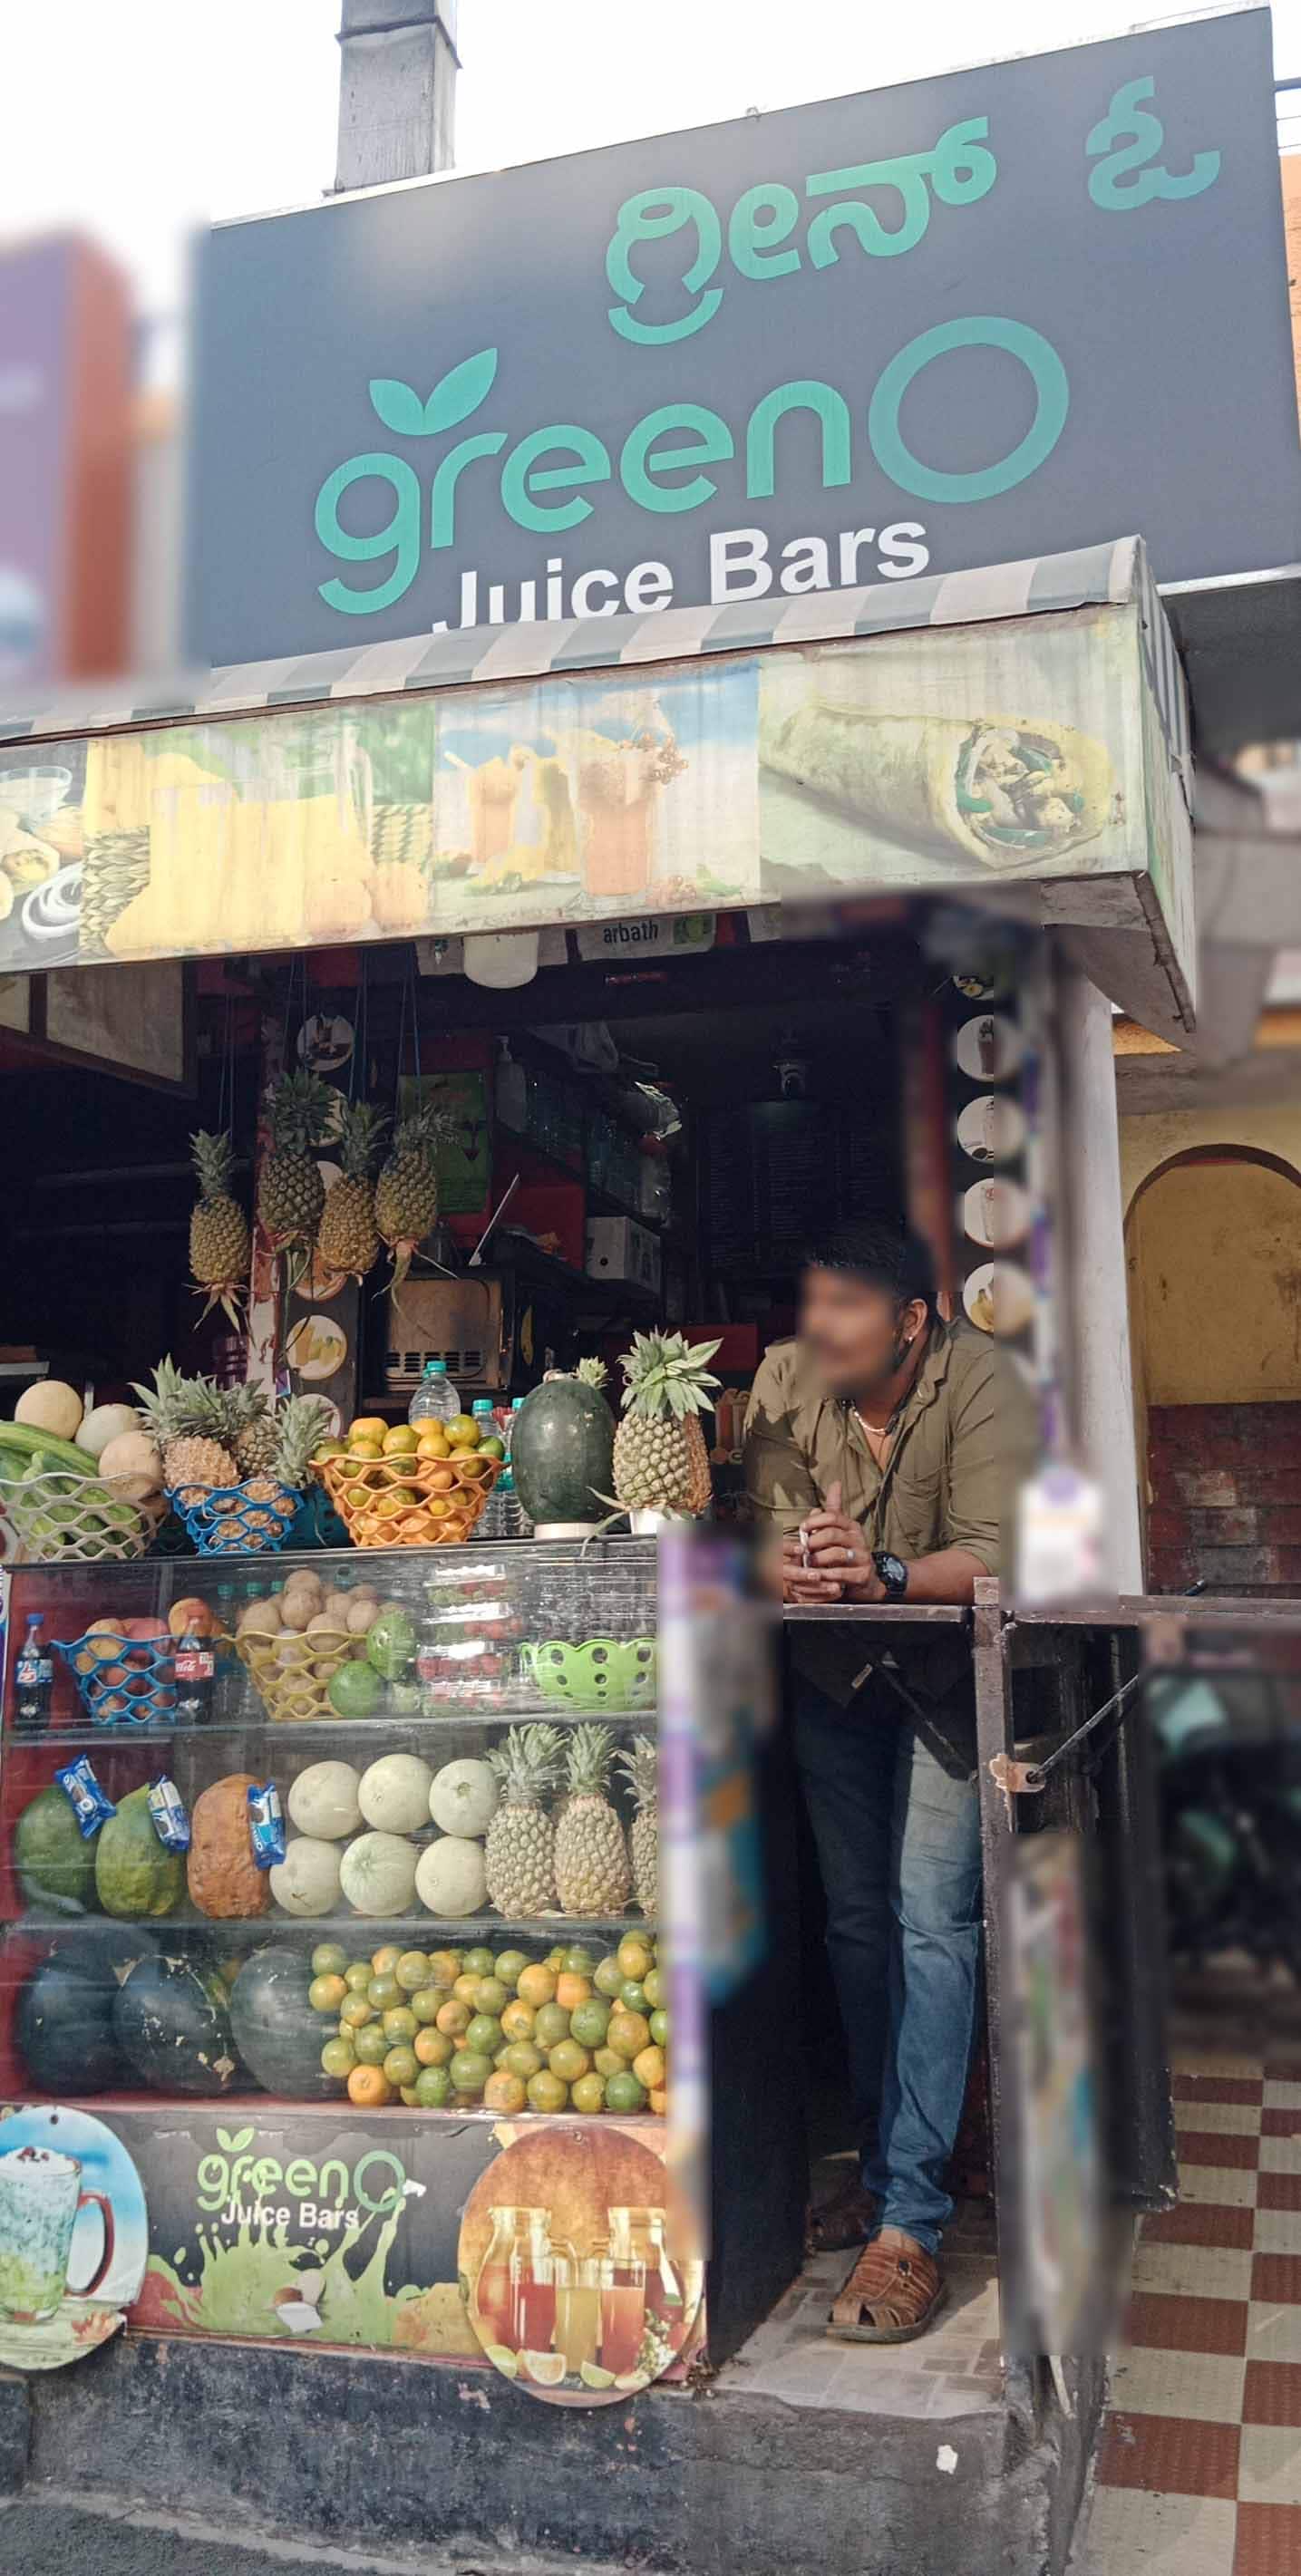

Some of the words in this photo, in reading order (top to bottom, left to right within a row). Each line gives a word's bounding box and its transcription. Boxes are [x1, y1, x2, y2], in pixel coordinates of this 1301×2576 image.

[606, 116, 998, 345] ಗ್ರೀನ್
[1085, 76, 1221, 211] ಓ
[432, 558, 675, 633] Juice
[709, 521, 930, 605] Bars
[221, 2197, 291, 2226] Juice
[299, 2203, 360, 2230] Bars
